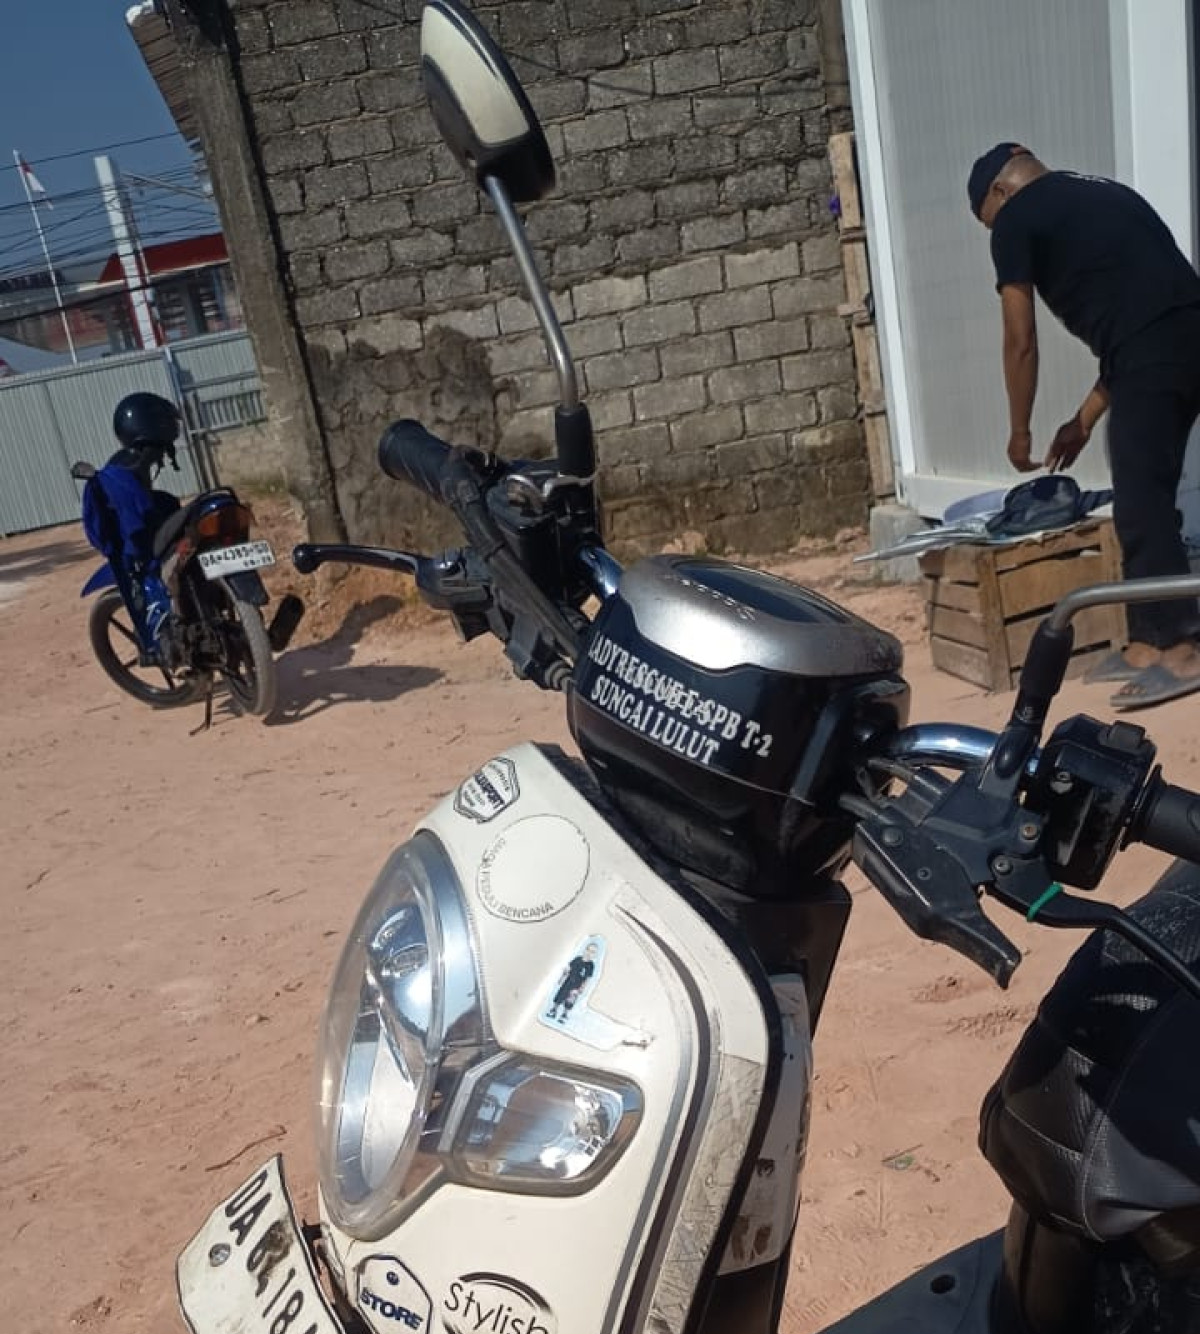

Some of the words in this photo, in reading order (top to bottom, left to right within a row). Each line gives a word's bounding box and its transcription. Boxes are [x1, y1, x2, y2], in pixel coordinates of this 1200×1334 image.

[591, 674, 653, 732] SUNGAI
[649, 710, 720, 765] LULUT
[225, 1169, 272, 1246] DA
[359, 1286, 424, 1331] STORE
